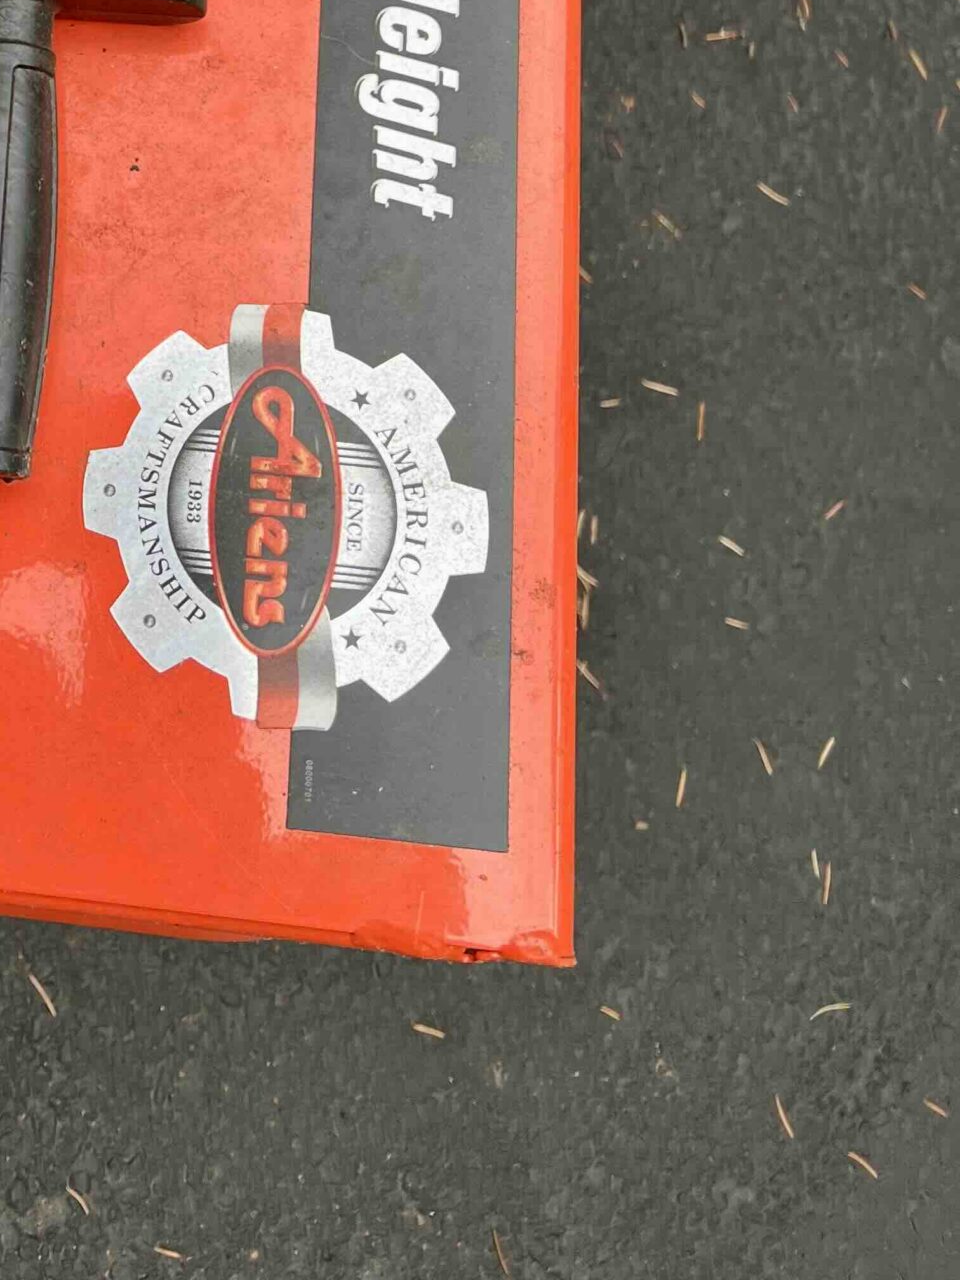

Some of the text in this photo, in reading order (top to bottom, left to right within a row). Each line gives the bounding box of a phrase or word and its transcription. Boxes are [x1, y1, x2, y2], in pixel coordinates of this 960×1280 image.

[137, 383, 216, 624] CRAFTSMANSHIP
[186, 480, 204, 524] 1933
[243, 385, 323, 628] Ariens
[346, 482, 365, 552] SINCE
[369, 425, 430, 628] AMERICAN
